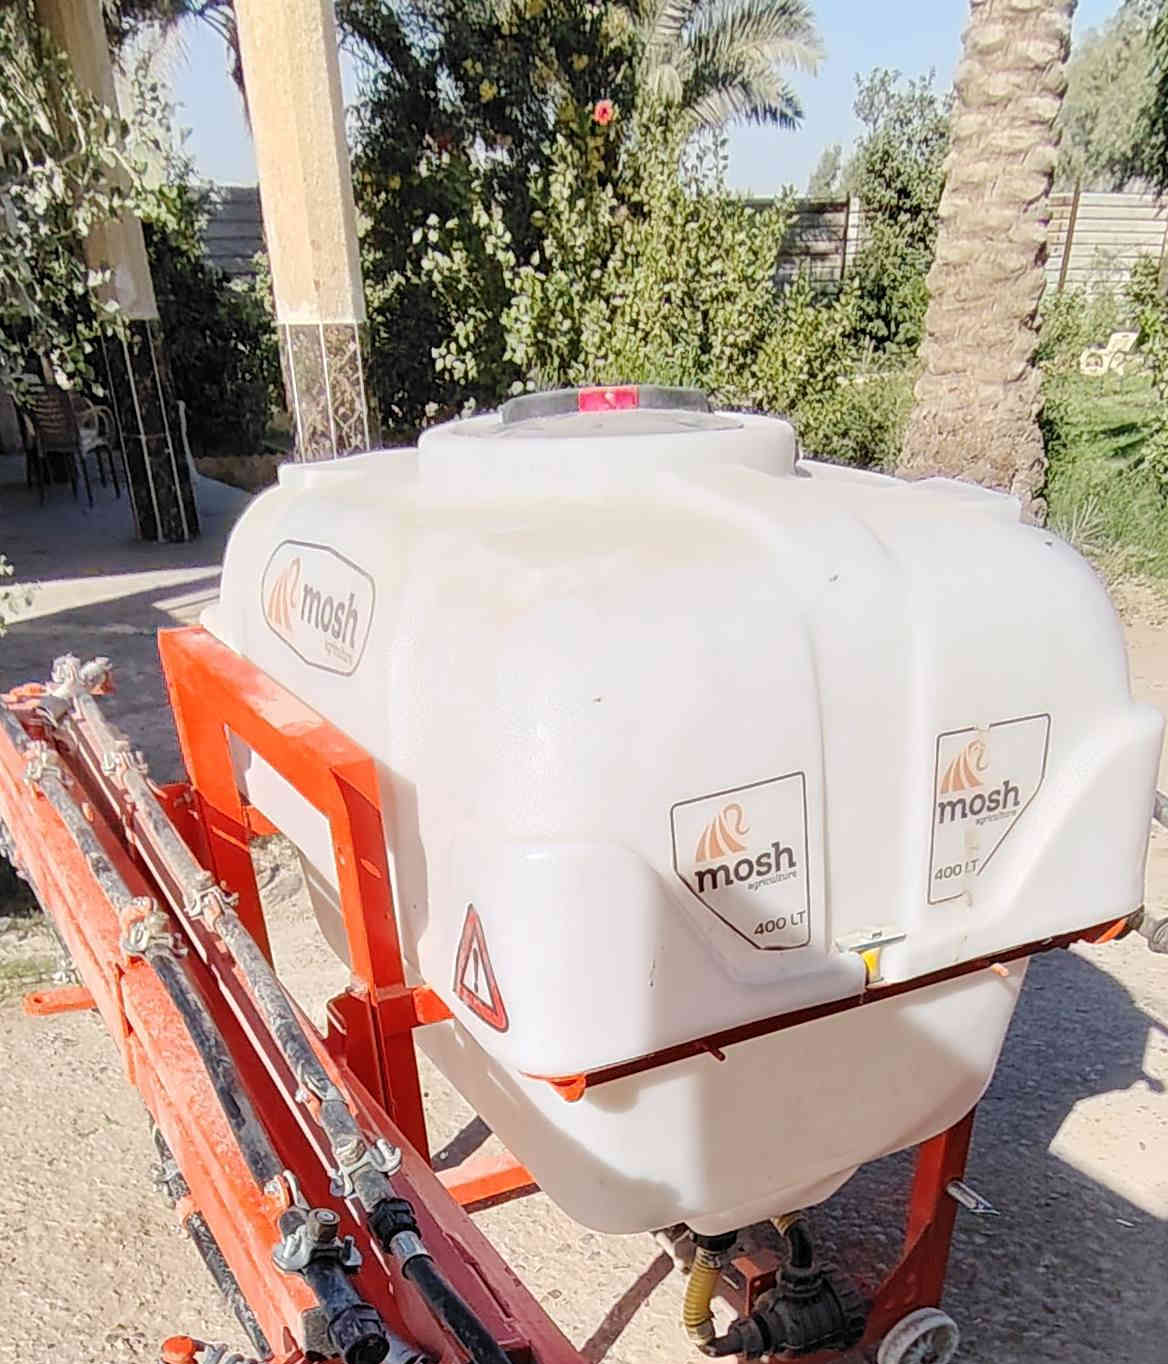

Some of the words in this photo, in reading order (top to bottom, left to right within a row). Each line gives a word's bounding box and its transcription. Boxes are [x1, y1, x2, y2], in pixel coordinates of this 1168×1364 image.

[301, 583, 358, 649] mosh
[937, 779, 1021, 825] mosh
[694, 841, 797, 893] mosh
[934, 863, 962, 881] 400
[964, 858, 980, 874] LT
[754, 916, 787, 935] 400
[790, 910, 806, 926] LT
